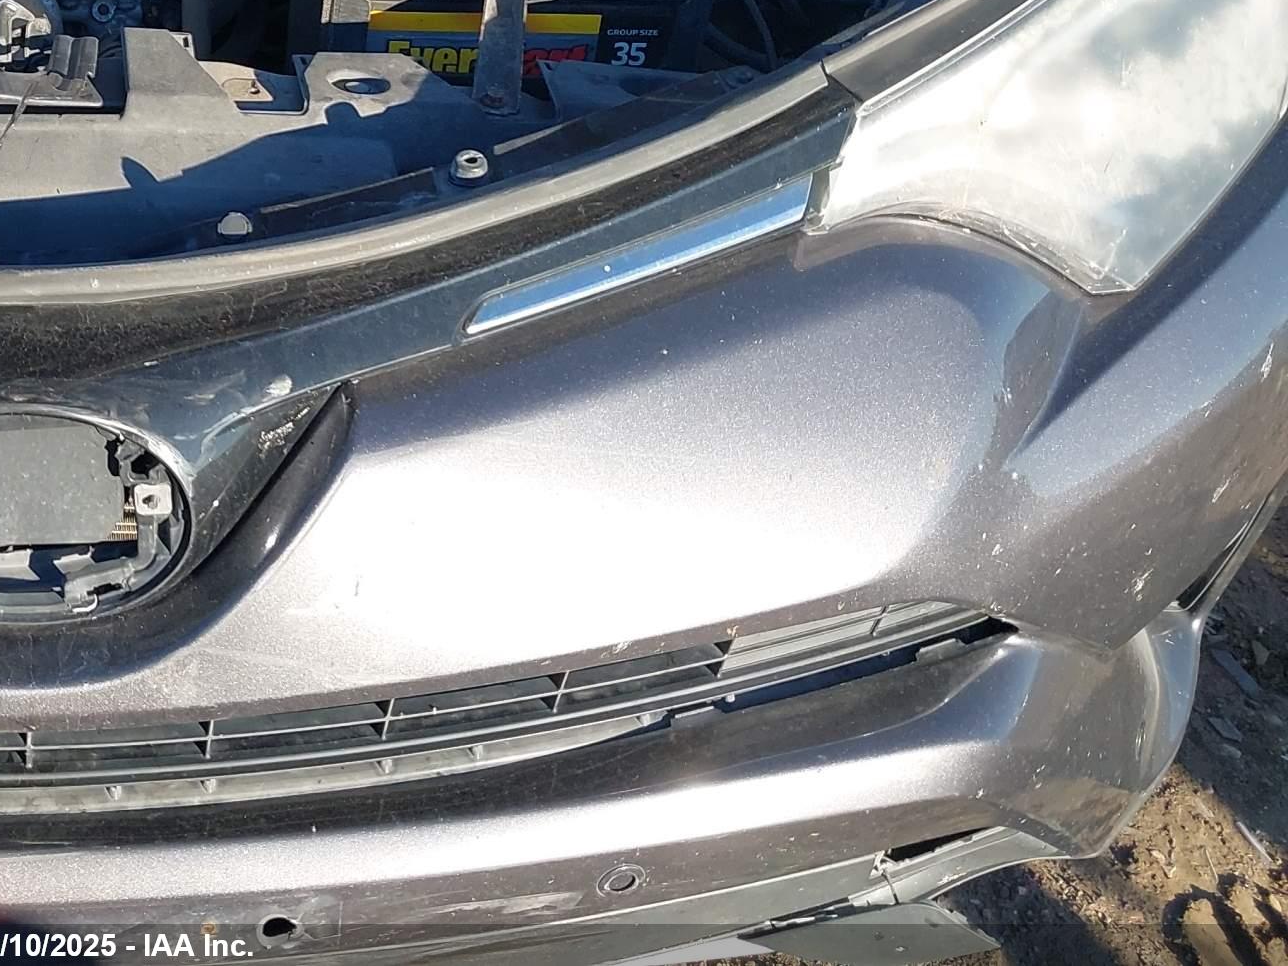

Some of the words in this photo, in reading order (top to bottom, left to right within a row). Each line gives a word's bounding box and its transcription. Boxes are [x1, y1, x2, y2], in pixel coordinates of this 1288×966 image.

[607, 28, 639, 36] GROUP
[639, 28, 659, 36] SIZE
[611, 41, 648, 66] 35
